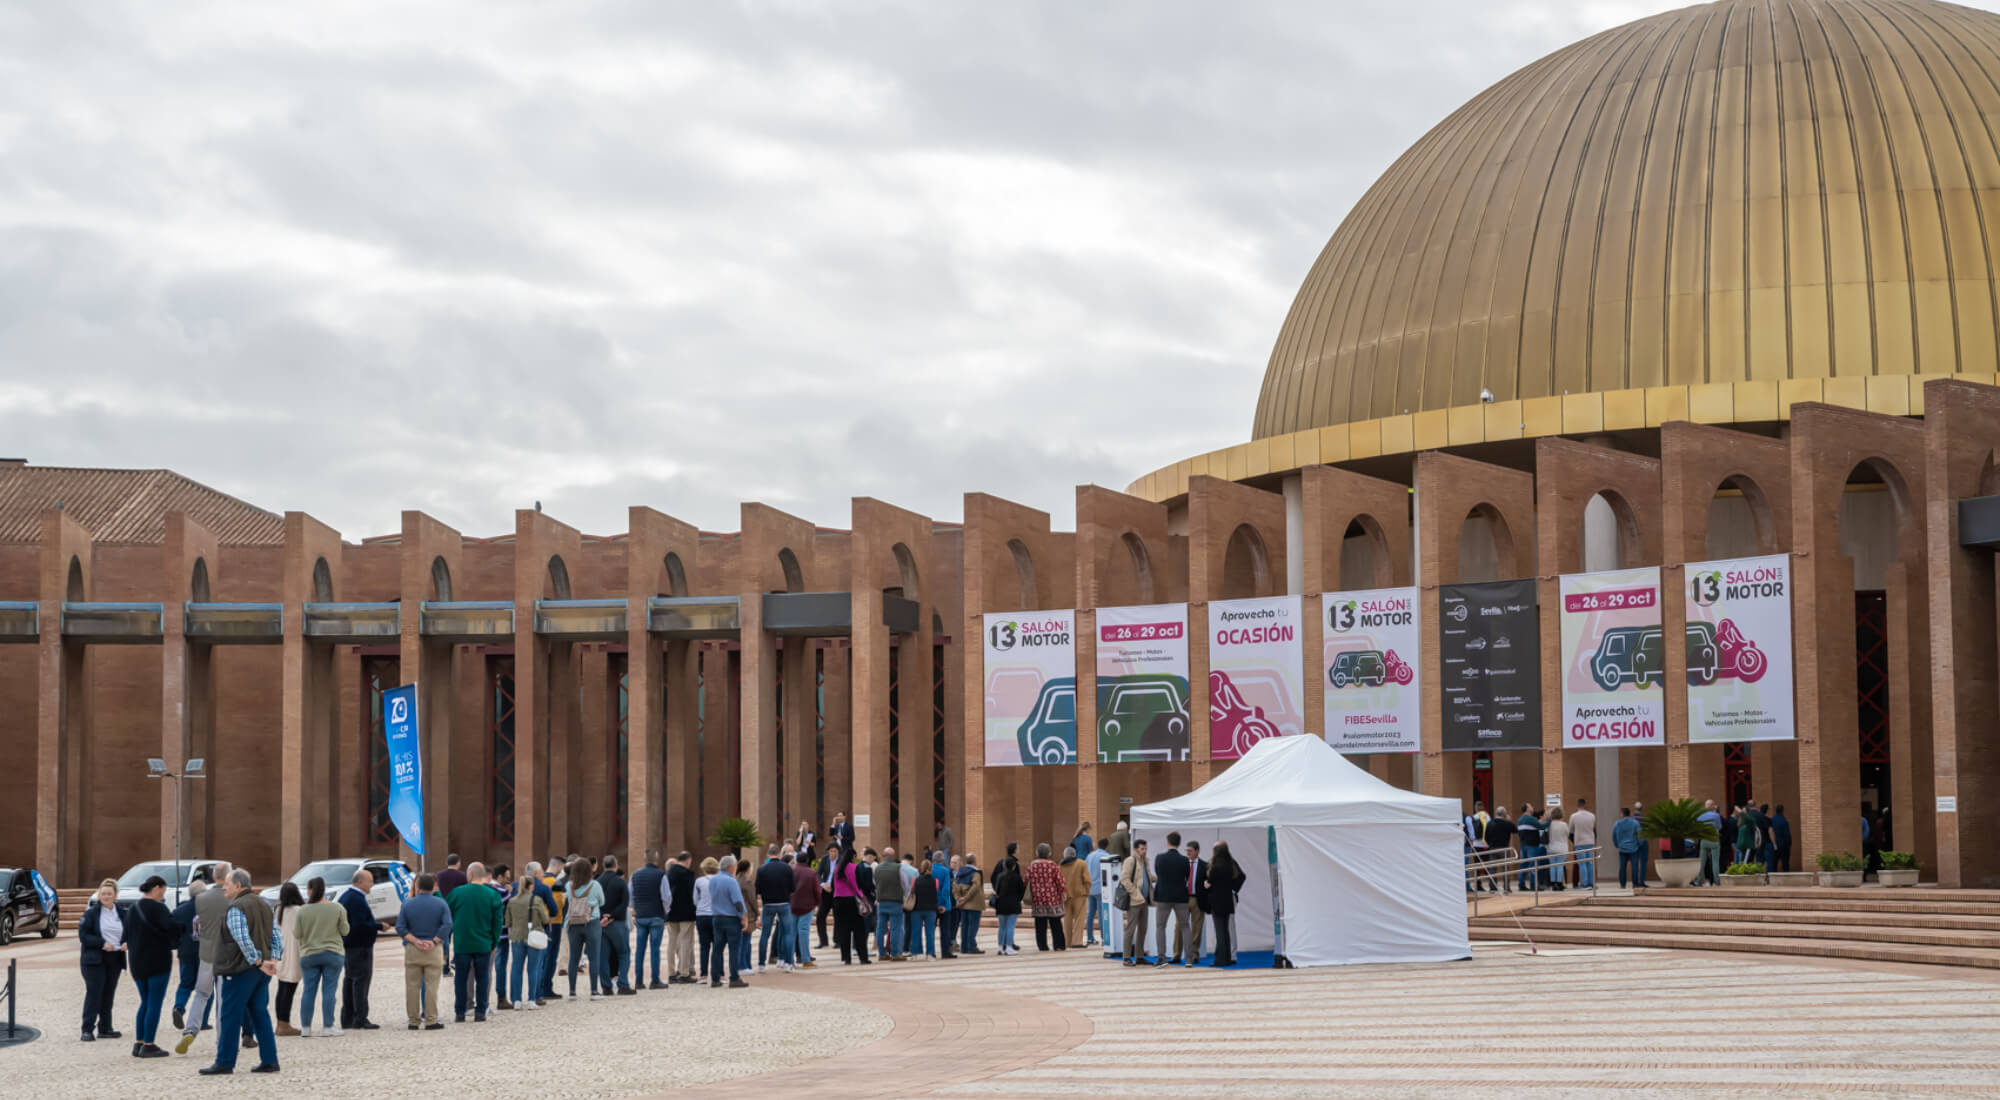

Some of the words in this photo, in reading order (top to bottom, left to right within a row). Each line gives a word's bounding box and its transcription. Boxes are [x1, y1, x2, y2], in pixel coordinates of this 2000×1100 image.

[1725, 565, 1777, 584] SALÓN
[1693, 575, 1720, 603] 13
[1726, 582, 1784, 601] MOTOR
[1360, 596, 1406, 613] SALÓN
[1569, 601, 1581, 610] del
[1582, 596, 1599, 609] 26
[1608, 593, 1625, 607] 29
[1628, 591, 1650, 605] oct
[1220, 608, 1275, 623] Aprovecha
[1277, 607, 1289, 617] tu
[1330, 604, 1356, 629] 13
[1360, 612, 1412, 628] MOTOR
[992, 623, 1017, 648] 13
[1021, 619, 1064, 634] SALÓN
[1117, 627, 1132, 639] 26
[1141, 626, 1156, 637] 29
[1159, 624, 1179, 637] oct
[1217, 622, 1294, 646] OCASIÓN
[1021, 633, 1070, 647] MOTOR
[1344, 713, 1398, 725] FIBESevilla
[1576, 705, 1635, 720] Aprovecha
[1638, 704, 1650, 716] tu
[1571, 716, 1655, 741] OCASIÓN
